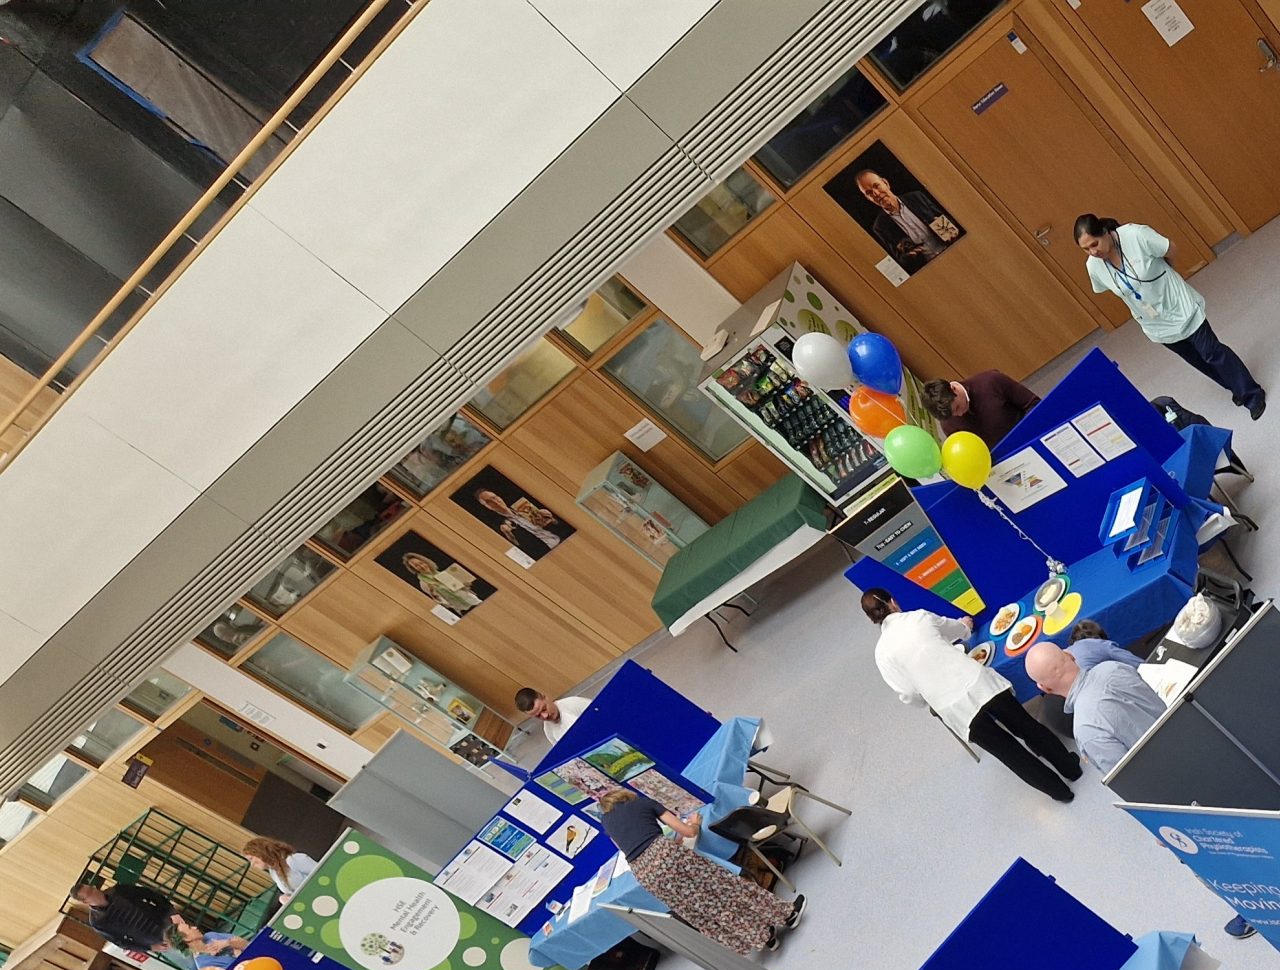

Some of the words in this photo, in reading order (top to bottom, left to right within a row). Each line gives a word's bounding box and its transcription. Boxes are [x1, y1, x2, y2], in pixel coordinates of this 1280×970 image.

[390, 909, 410, 931] Mental
[407, 890, 427, 912] Health
[400, 898, 432, 934] Engagement
[415, 904, 439, 931] Recovery
